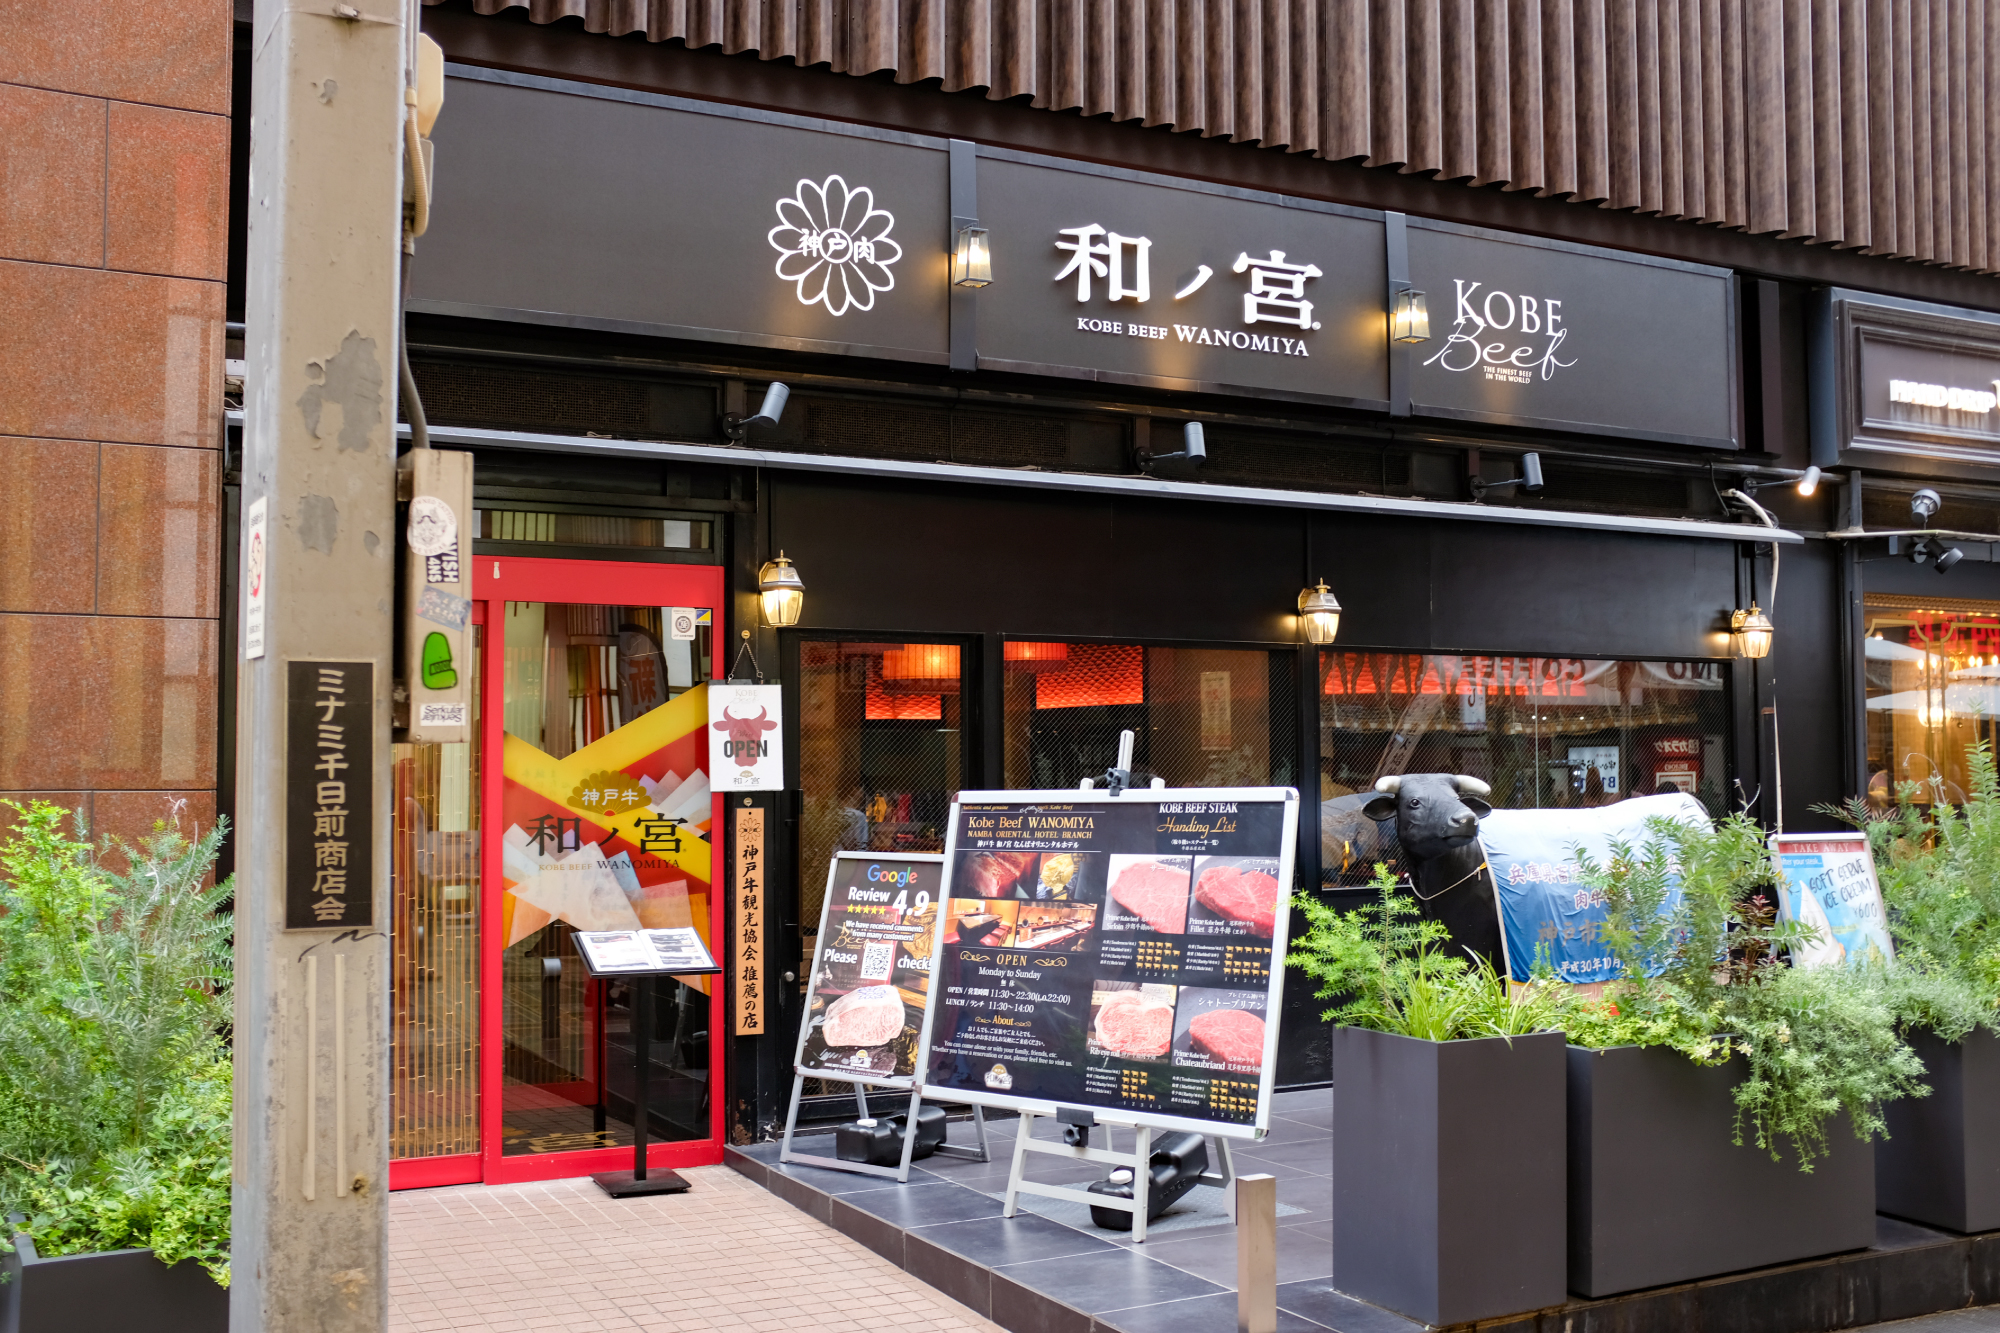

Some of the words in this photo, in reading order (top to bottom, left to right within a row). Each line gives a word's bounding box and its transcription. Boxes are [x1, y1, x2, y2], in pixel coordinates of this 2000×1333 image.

[798, 229, 875, 264] 神戸肉
[1453, 279, 1562, 337] KOBE
[1077, 318, 1122, 335] KOBE
[1128, 324, 1168, 340] BEEF
[1173, 324, 1309, 357] WANOMIYA
[1423, 315, 1578, 380] Beef
[1483, 366, 1496, 374] THE
[1497, 367, 1518, 376] FINEST
[1519, 370, 1533, 378] BEEF
[1495, 374, 1507, 382] THE
[1508, 376, 1531, 384] WORLD
[424, 705, 463, 717] Serkular
[724, 740, 767, 758] OPEN
[311, 667, 350, 922] ミナミ千日前商店会
[582, 788, 639, 806] 神戸牛
[1159, 802, 1183, 813] KOBE
[1185, 802, 1208, 813] BEEF
[1209, 802, 1238, 813] STEAK
[968, 817, 995, 828] Kobe
[999, 816, 1023, 828] Beef
[1028, 817, 1094, 829] WANOMIYA
[1157, 816, 1210, 839] Handing
[1210, 816, 1237, 832] List
[526, 813, 688, 857] 和ノ宮
[967, 830, 992, 838] NAMBA
[1062, 831, 1092, 839] BRANCH
[977, 840, 995, 848] 神戸牛
[1013, 841, 1080, 849] なんばオリエンタルホテル
[1792, 843, 1819, 853] TAKE
[1823, 842, 1850, 853] AWAY
[569, 863, 593, 871] BEEF
[597, 859, 680, 870] WANOMIYA
[1150, 864, 1187, 872] サーロイン
[1253, 867, 1278, 876] フィレ
[867, 864, 918, 887] Google
[1809, 868, 1834, 894] SOFT
[1837, 859, 1865, 882] SERVE
[1823, 890, 1839, 910] ICE
[1840, 878, 1872, 903] CREAM
[848, 886, 890, 903] Review
[892, 889, 930, 916] 4.9
[845, 920, 855, 928] We
[855, 921, 869, 929] have
[869, 922, 894, 931] received
[894, 924, 924, 933] comments
[1189, 918, 1204, 926] Prime
[852, 929, 867, 938] from
[867, 931, 883, 941] many
[883, 932, 915, 942] customers!
[1190, 925, 1205, 933] Fillet
[823, 948, 857, 964] Please
[897, 955, 931, 971] check!
[996, 953, 1028, 966] OPEN
[978, 966, 1006, 978] Monday
[1007, 969, 1014, 977] to
[1015, 969, 1042, 980] Sunday
[947, 986, 963, 994] OPEN
[946, 998, 965, 1006] LUNCH
[1198, 998, 1265, 1010] シャトーブリアン
[992, 1015, 1015, 1026] About
[1090, 1046, 1100, 1055] Rib
[1100, 1049, 1110, 1058] eye
[1110, 1049, 1120, 1057] roll
[1173, 1049, 1189, 1057] Prime
[1175, 1057, 1225, 1071] Chateaubriand
